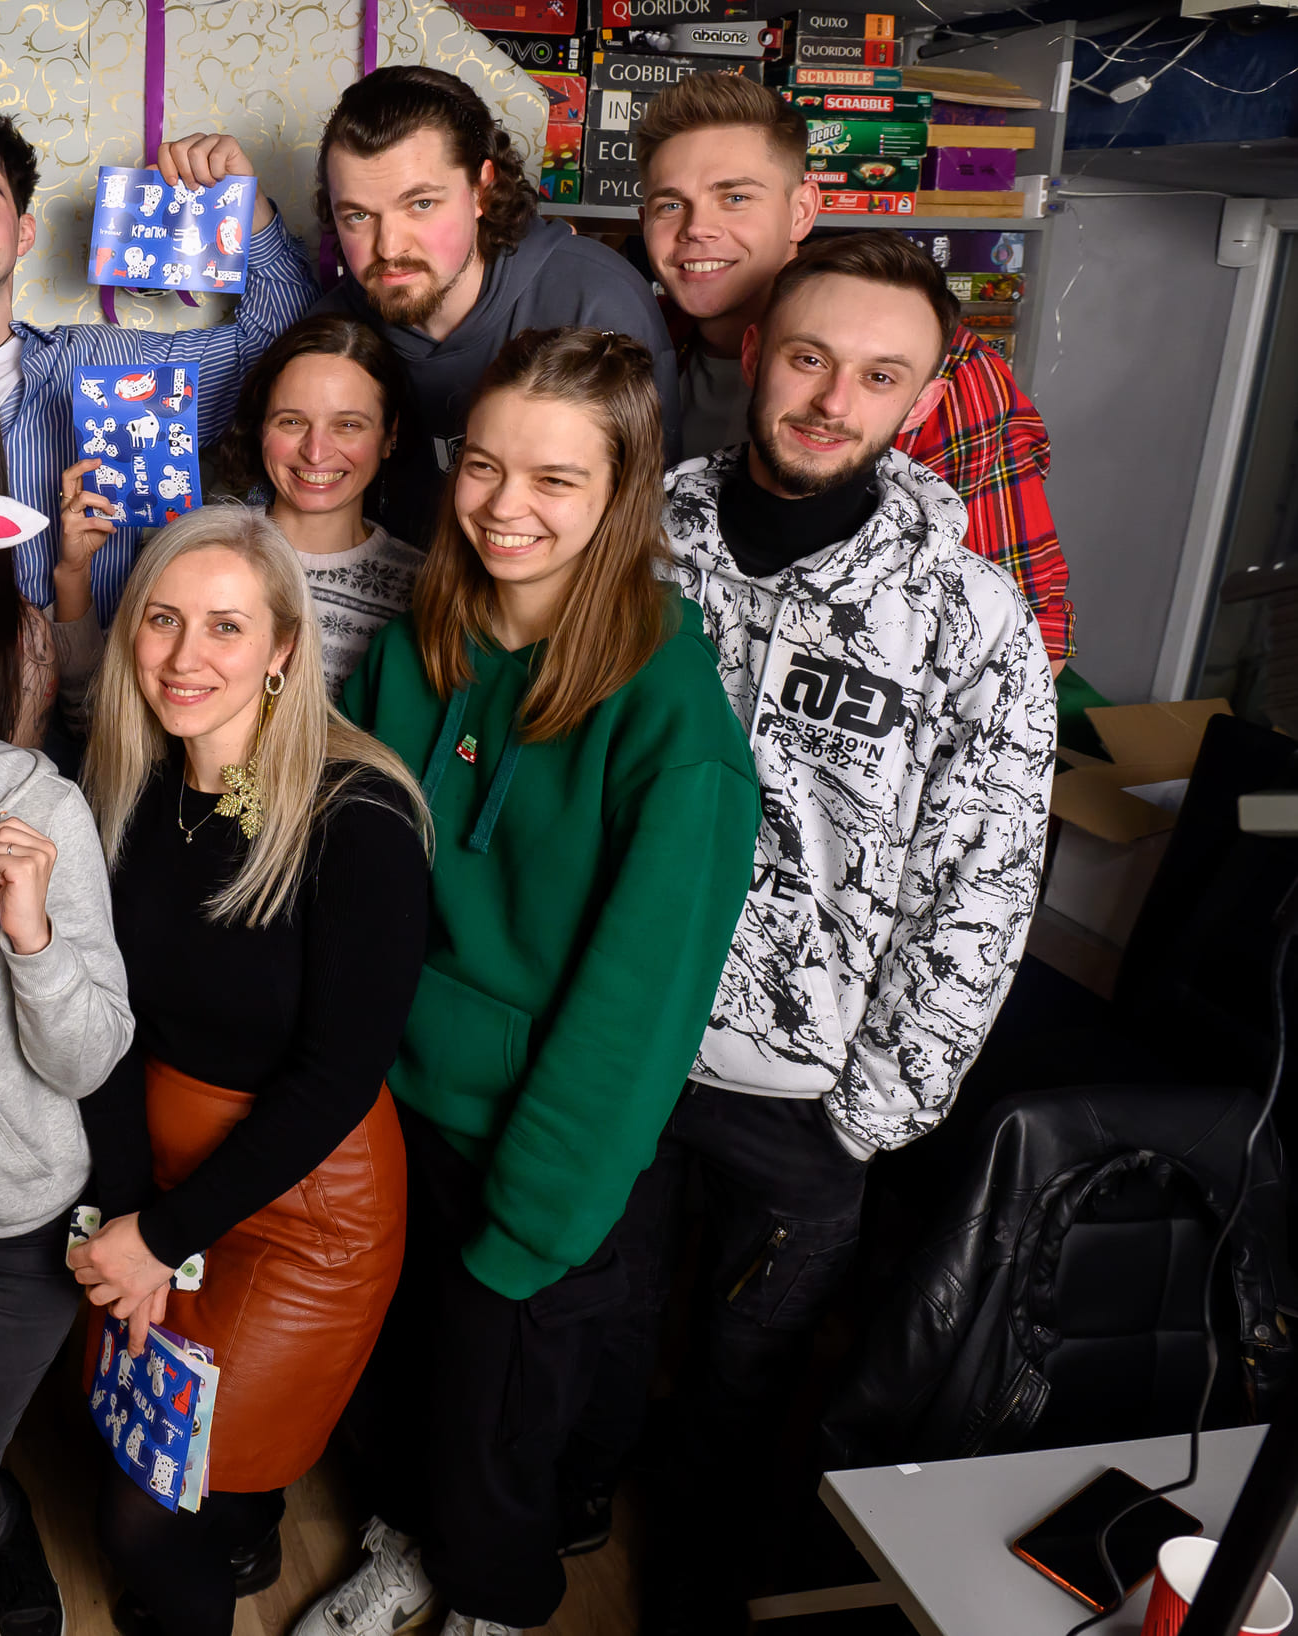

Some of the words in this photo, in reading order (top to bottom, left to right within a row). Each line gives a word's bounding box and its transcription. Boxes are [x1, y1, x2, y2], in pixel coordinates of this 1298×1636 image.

[612, 0, 711, 20] QUORIDOR
[810, 16, 849, 29] QUIXO
[692, 30, 746, 44] abalone
[802, 44, 862, 58] QUORIDOR
[799, 70, 874, 86] SCRABBLE
[609, 100, 648, 120] INS
[827, 97, 892, 112] SCRABBLE
[598, 142, 640, 160] ECL
